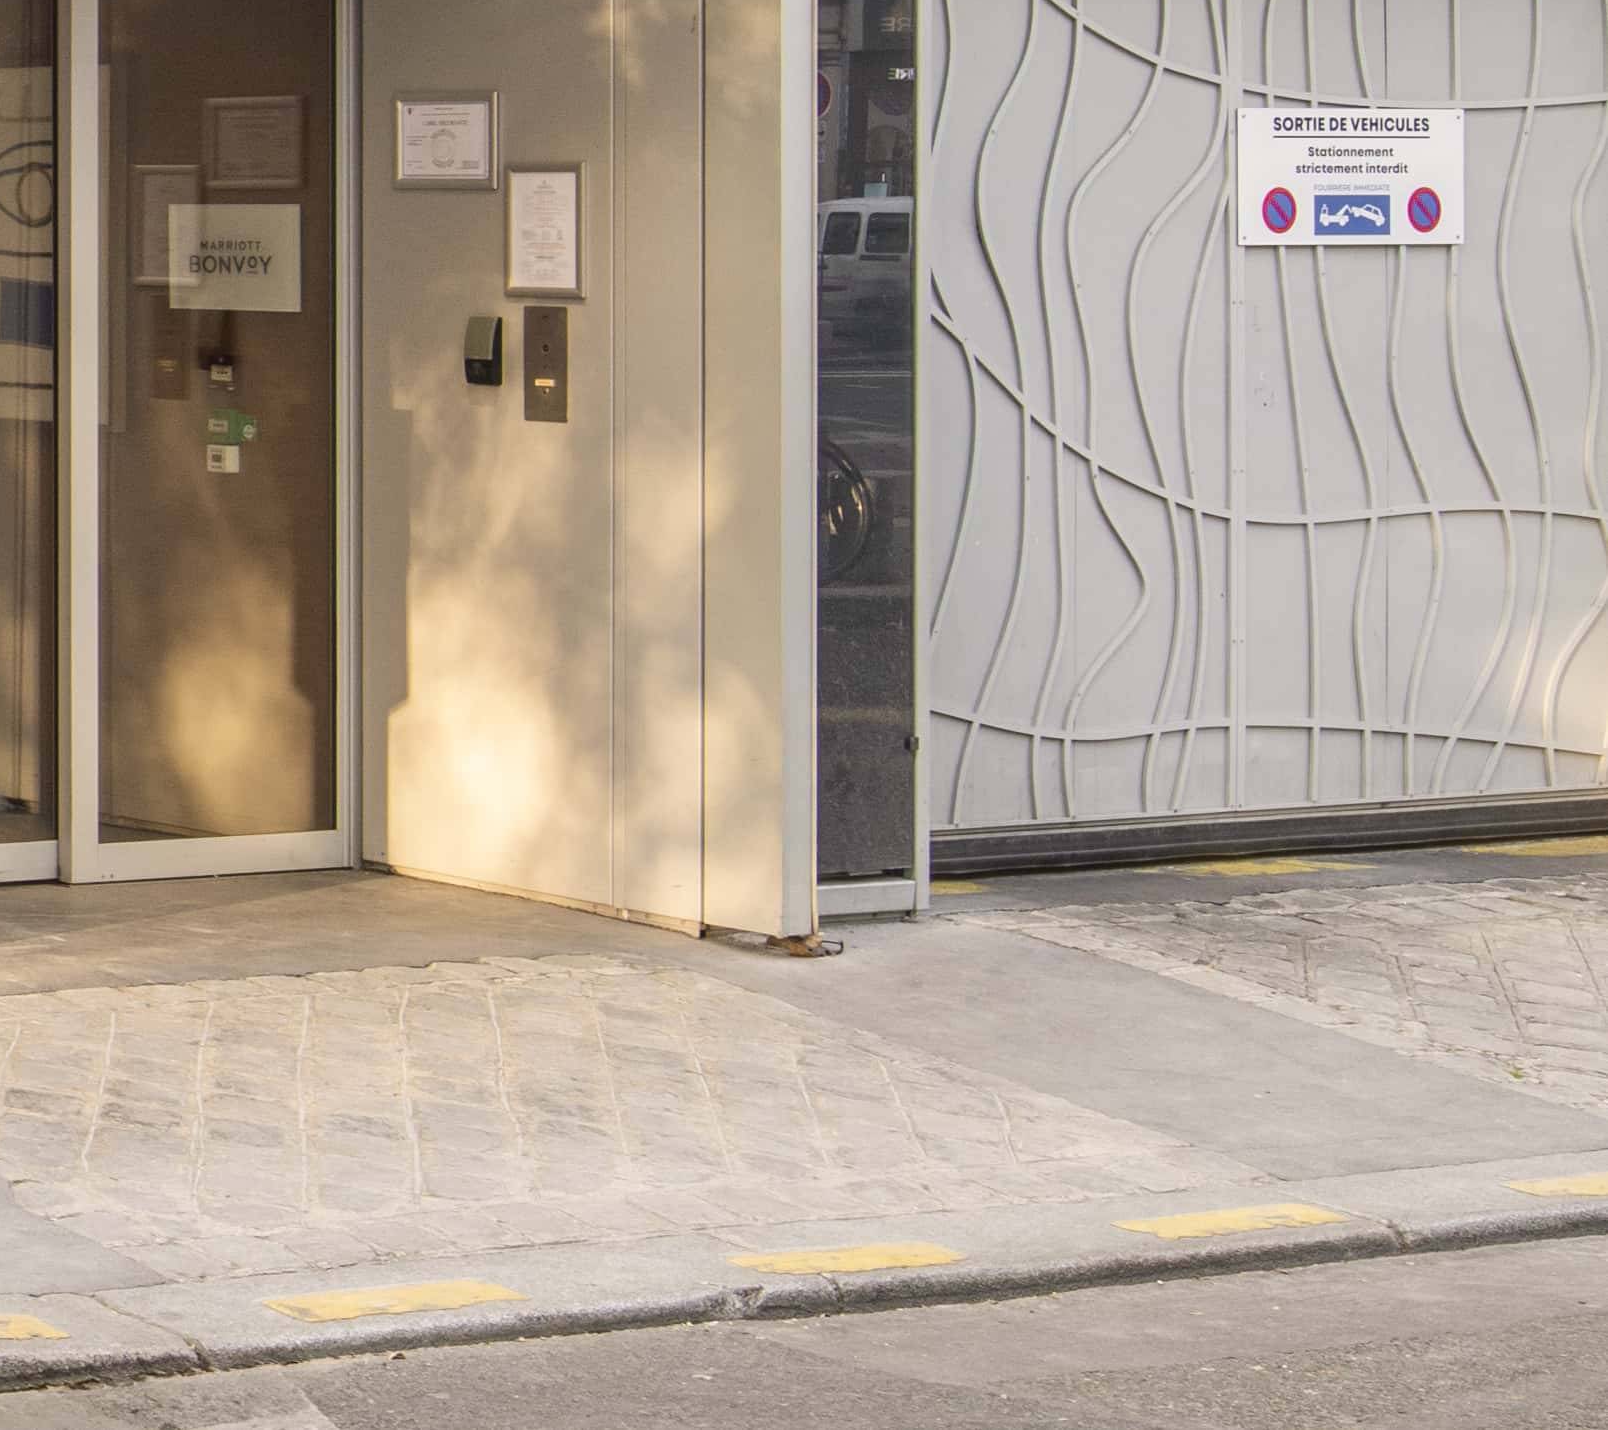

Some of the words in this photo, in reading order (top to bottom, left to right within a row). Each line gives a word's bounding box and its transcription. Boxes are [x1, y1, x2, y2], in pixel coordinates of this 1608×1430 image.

[1273, 116, 1325, 132] SORTIE
[1329, 117, 1347, 132] DE
[1350, 117, 1430, 132] VEHICULES
[1307, 146, 1394, 157] Stationnement
[1295, 162, 1363, 174] strictement
[1365, 162, 1409, 174] interdit
[199, 240, 262, 251] MARRIOTT
[189, 254, 272, 275] BONVOY
